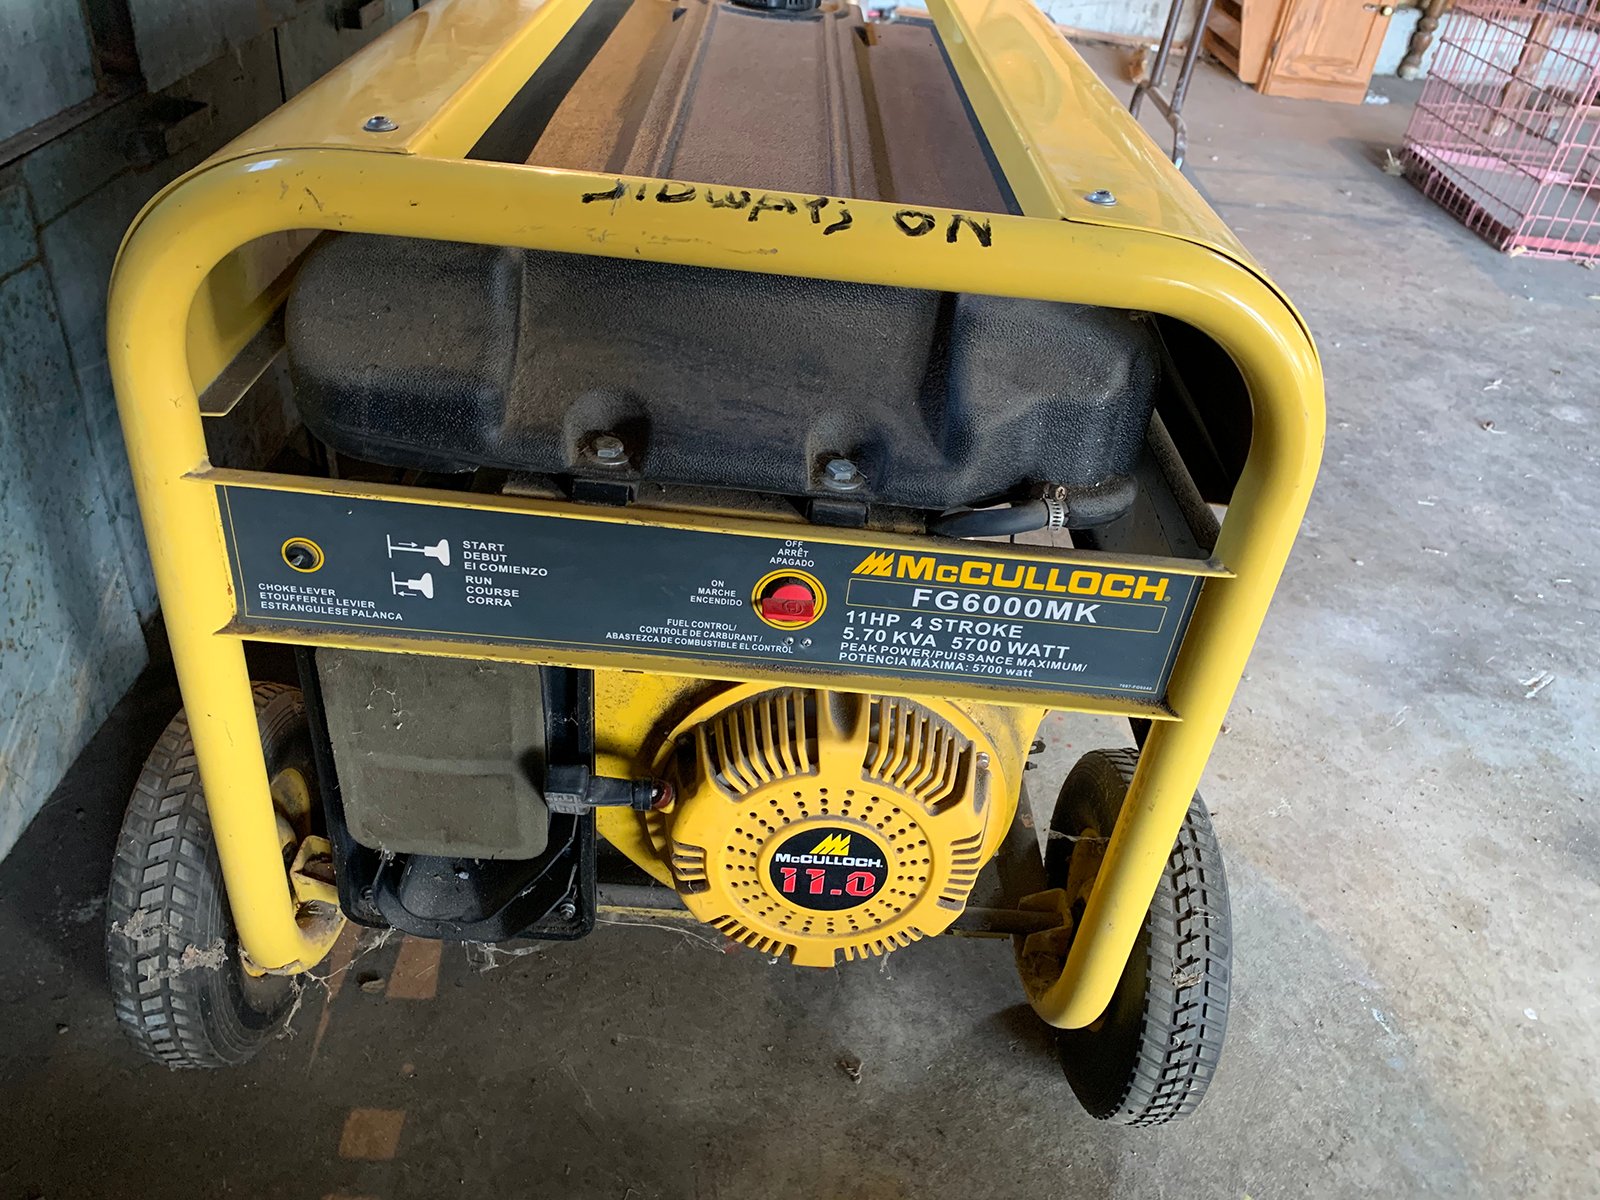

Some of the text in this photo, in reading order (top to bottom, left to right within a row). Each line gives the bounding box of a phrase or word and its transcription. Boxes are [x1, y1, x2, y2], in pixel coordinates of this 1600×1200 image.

[895, 209, 992, 247] ON
[462, 540, 505, 552] START
[785, 540, 803, 548] OFF
[463, 551, 507, 562] DEBUT
[777, 547, 809, 558] ARRÊT
[479, 562, 548, 576] COMIENZO
[769, 557, 815, 567] APAGADO
[465, 575, 492, 585] RUN
[711, 579, 725, 588] ON
[896, 554, 1169, 601] McCULLOCH
[258, 582, 336, 596] CHOKE LEVER
[466, 585, 520, 598] COURSE
[697, 587, 736, 597] MARCHE
[259, 592, 376, 609] ETOUFFER LE LEVIER
[466, 595, 513, 607] CORRA
[690, 595, 743, 607] ENCENDIDO
[911, 588, 1101, 624] FG6000MK
[260, 601, 403, 621] ESTRANGULESE PALANCA
[666, 618, 690, 628] FUEL
[846, 610, 1024, 639] 11HP 4 STROKE
[639, 625, 688, 637] CONTROLE
[689, 629, 702, 638] DE
[703, 630, 758, 642] CARBURANT
[605, 631, 660, 643] ABASTEZCA
[661, 636, 673, 644] DE
[674, 637, 738, 649] COMBUSTIBLE
[739, 642, 750, 651] EL
[842, 626, 1070, 659] 5.70 KVA 5700 WATT
[840, 642, 878, 654] PEAK
[1016, 658, 1088, 673] MAXIMUM/
[839, 652, 1034, 678] POTENCIA MÁXIMA: 5700 watt
[780, 866, 876, 897] 11.0
